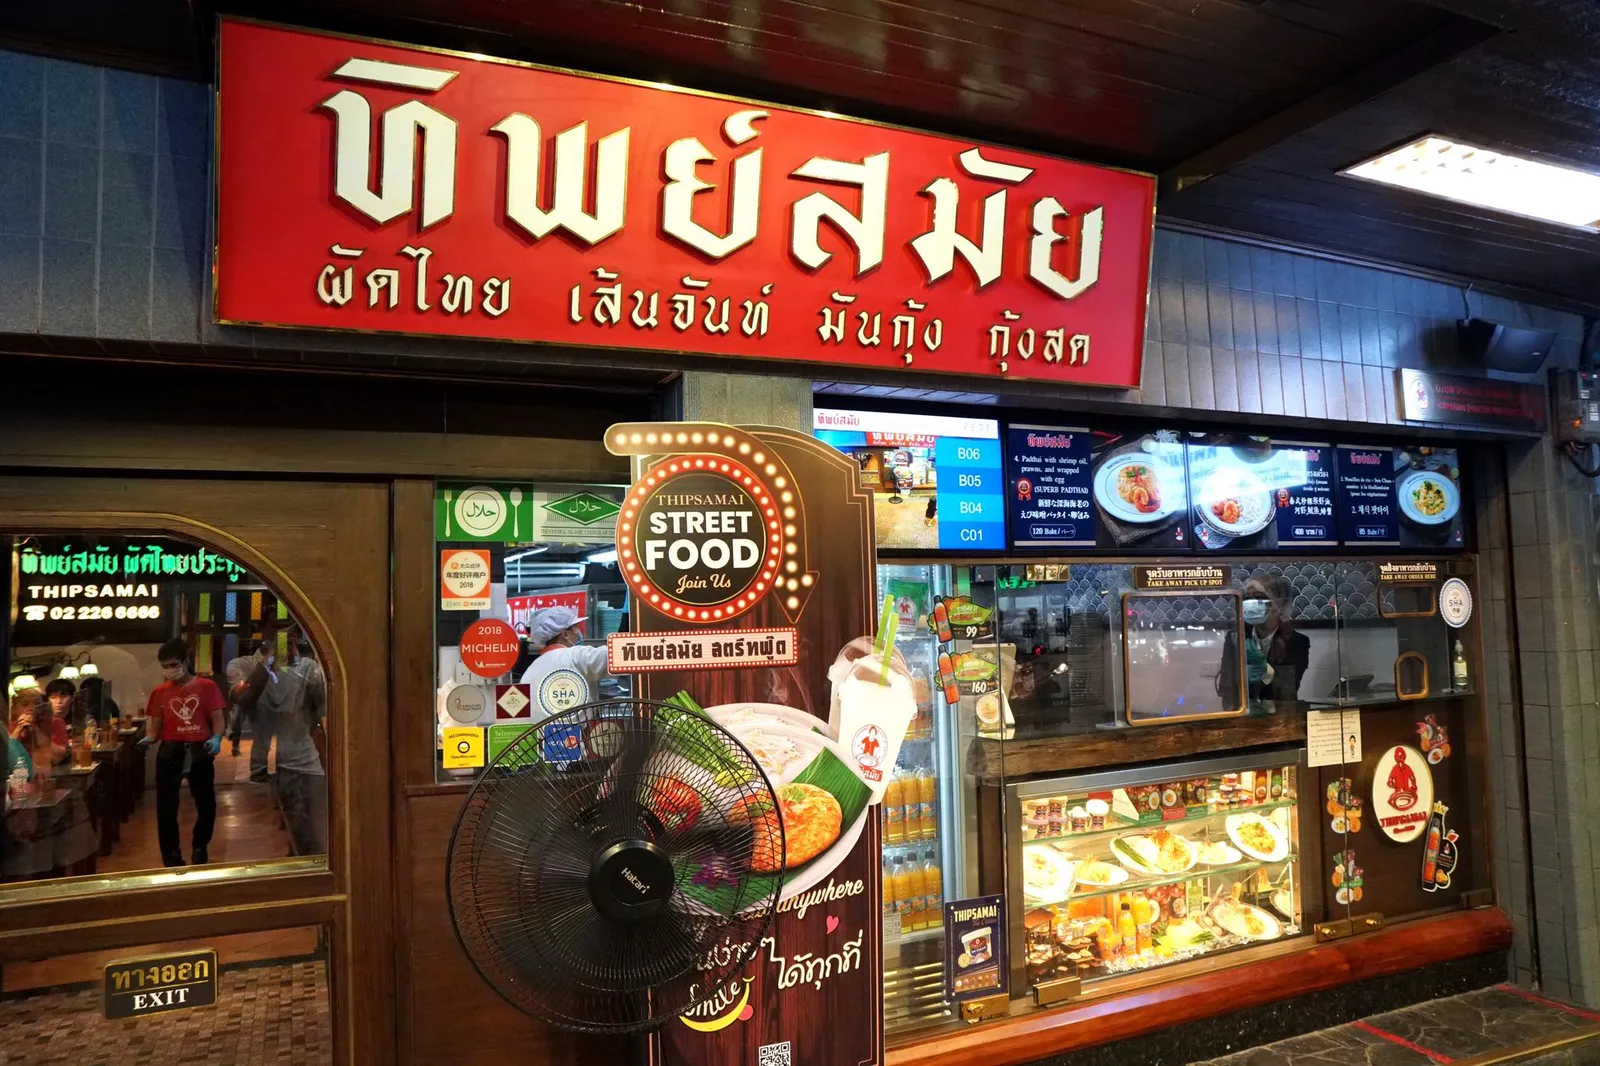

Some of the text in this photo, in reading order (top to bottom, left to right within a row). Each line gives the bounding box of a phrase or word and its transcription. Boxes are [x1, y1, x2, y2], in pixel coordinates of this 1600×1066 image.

[319, 56, 1105, 301] ทิพย์สมัย
[316, 245, 1092, 376] ผัดไทย เส้นจันท์ มันกุ้ง กุ้งสด
[957, 448, 981, 460] B06
[1058, 457, 1077, 466] shrimp
[1056, 467, 1080, 475] wrapped
[958, 475, 981, 487] B05
[1054, 477, 1065, 485] egg
[1034, 486, 1089, 494] (SUPERB PADTHAI)
[569, 497, 602, 514] حلال
[655, 494, 745, 506] THIPSAMAI
[466, 502, 496, 518] حلال
[960, 502, 982, 514] B04
[650, 510, 753, 534] STREET
[960, 529, 983, 541] C01
[645, 538, 759, 571] FOOD
[20, 544, 247, 583] ทิพย์สมัย ผัดไทยประตู
[1146, 566, 1223, 580] จุดรับอาหารกลับบ้าน
[675, 573, 732, 594] Join Us
[28, 584, 159, 599] THIPSAMAI
[50, 605, 161, 620] 02 226 6666
[478, 626, 502, 635] 2018
[966, 626, 977, 637] 99
[461, 643, 519, 653] MICHELIN
[621, 637, 703, 662] ทิพย์สมัย
[552, 690, 576, 699] SHA
[971, 681, 987, 693] 160
[621, 867, 650, 894] Hatari
[776, 877, 864, 920] anywhere
[954, 904, 997, 923] THIPSAMAI
[112, 959, 209, 990] ทางออก
[132, 987, 190, 1010] EXIT
